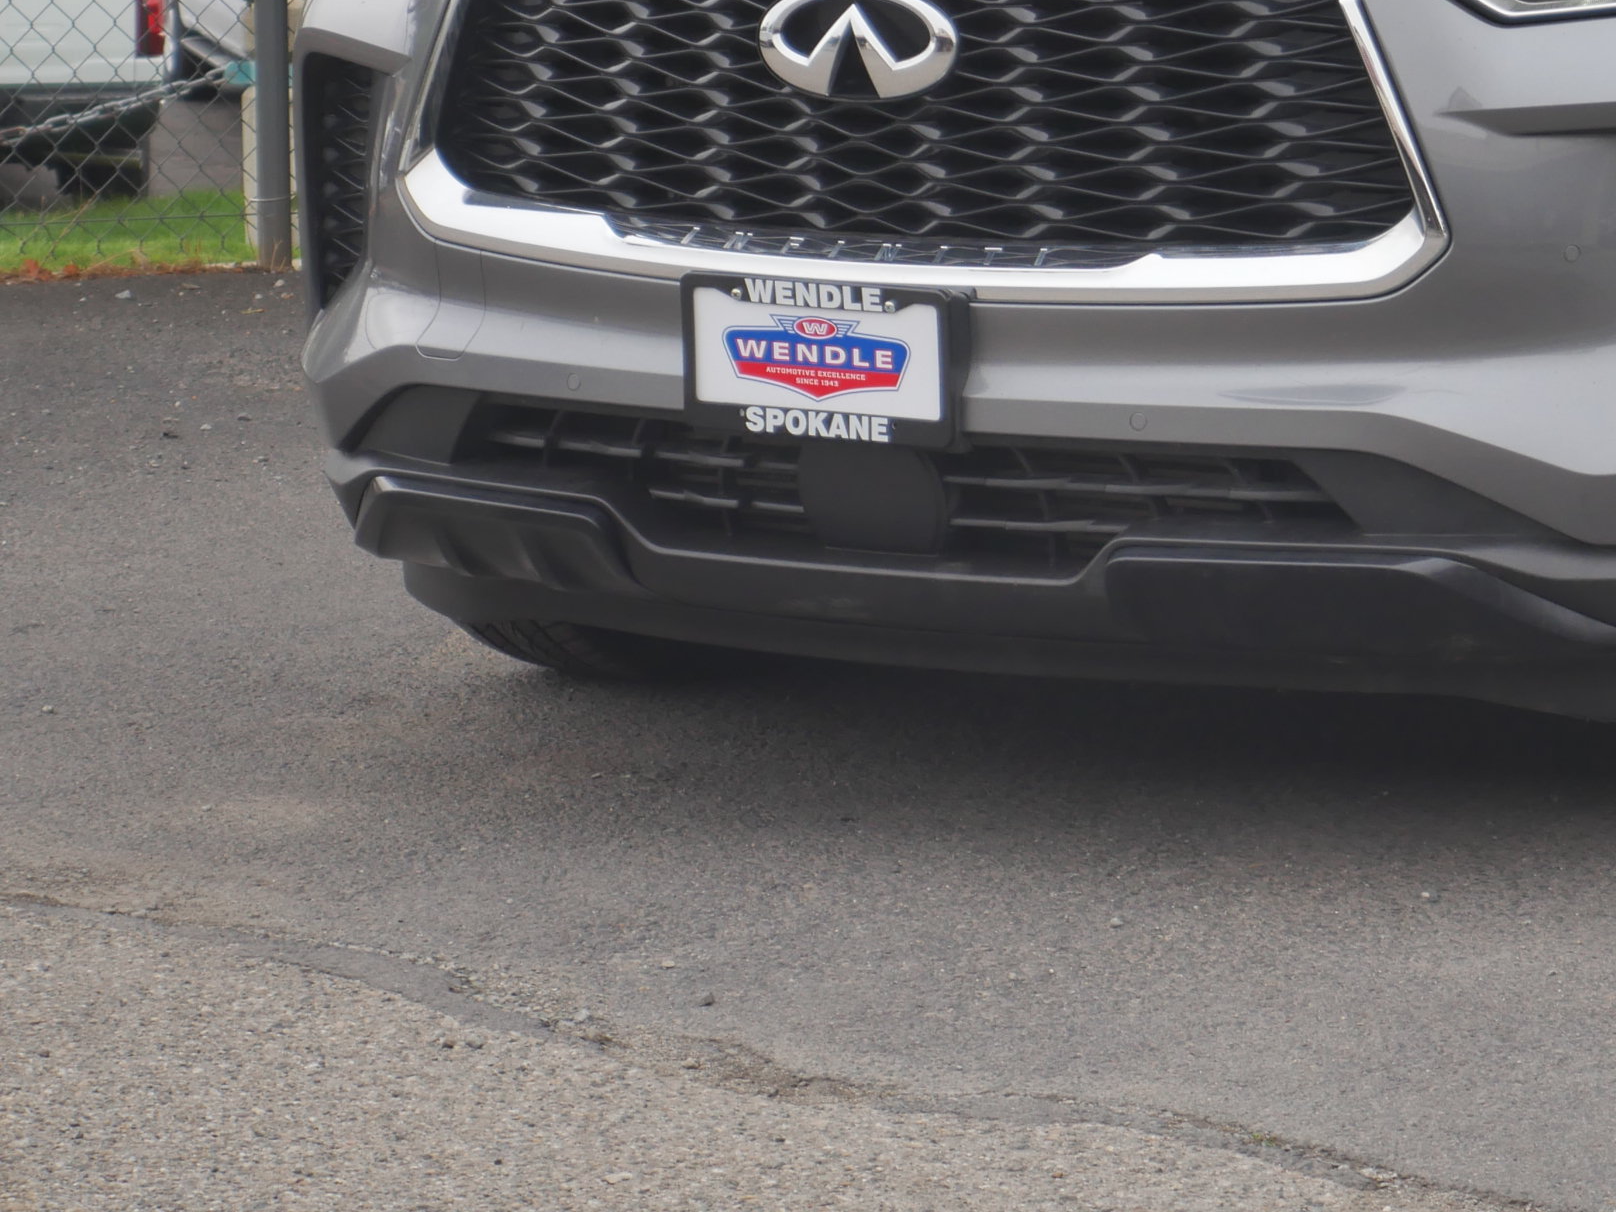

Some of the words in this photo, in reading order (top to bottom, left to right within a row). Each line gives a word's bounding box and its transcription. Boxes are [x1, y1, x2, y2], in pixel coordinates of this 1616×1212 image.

[744, 277, 883, 313] WENDLE
[736, 338, 894, 370] WENDLE
[765, 366, 816, 377] AUTOMOTIVE
[817, 370, 867, 381] EXCELLENCE
[795, 377, 819, 387] SINCE
[820, 379, 840, 387] 1943
[745, 406, 889, 443] SPOKANE
